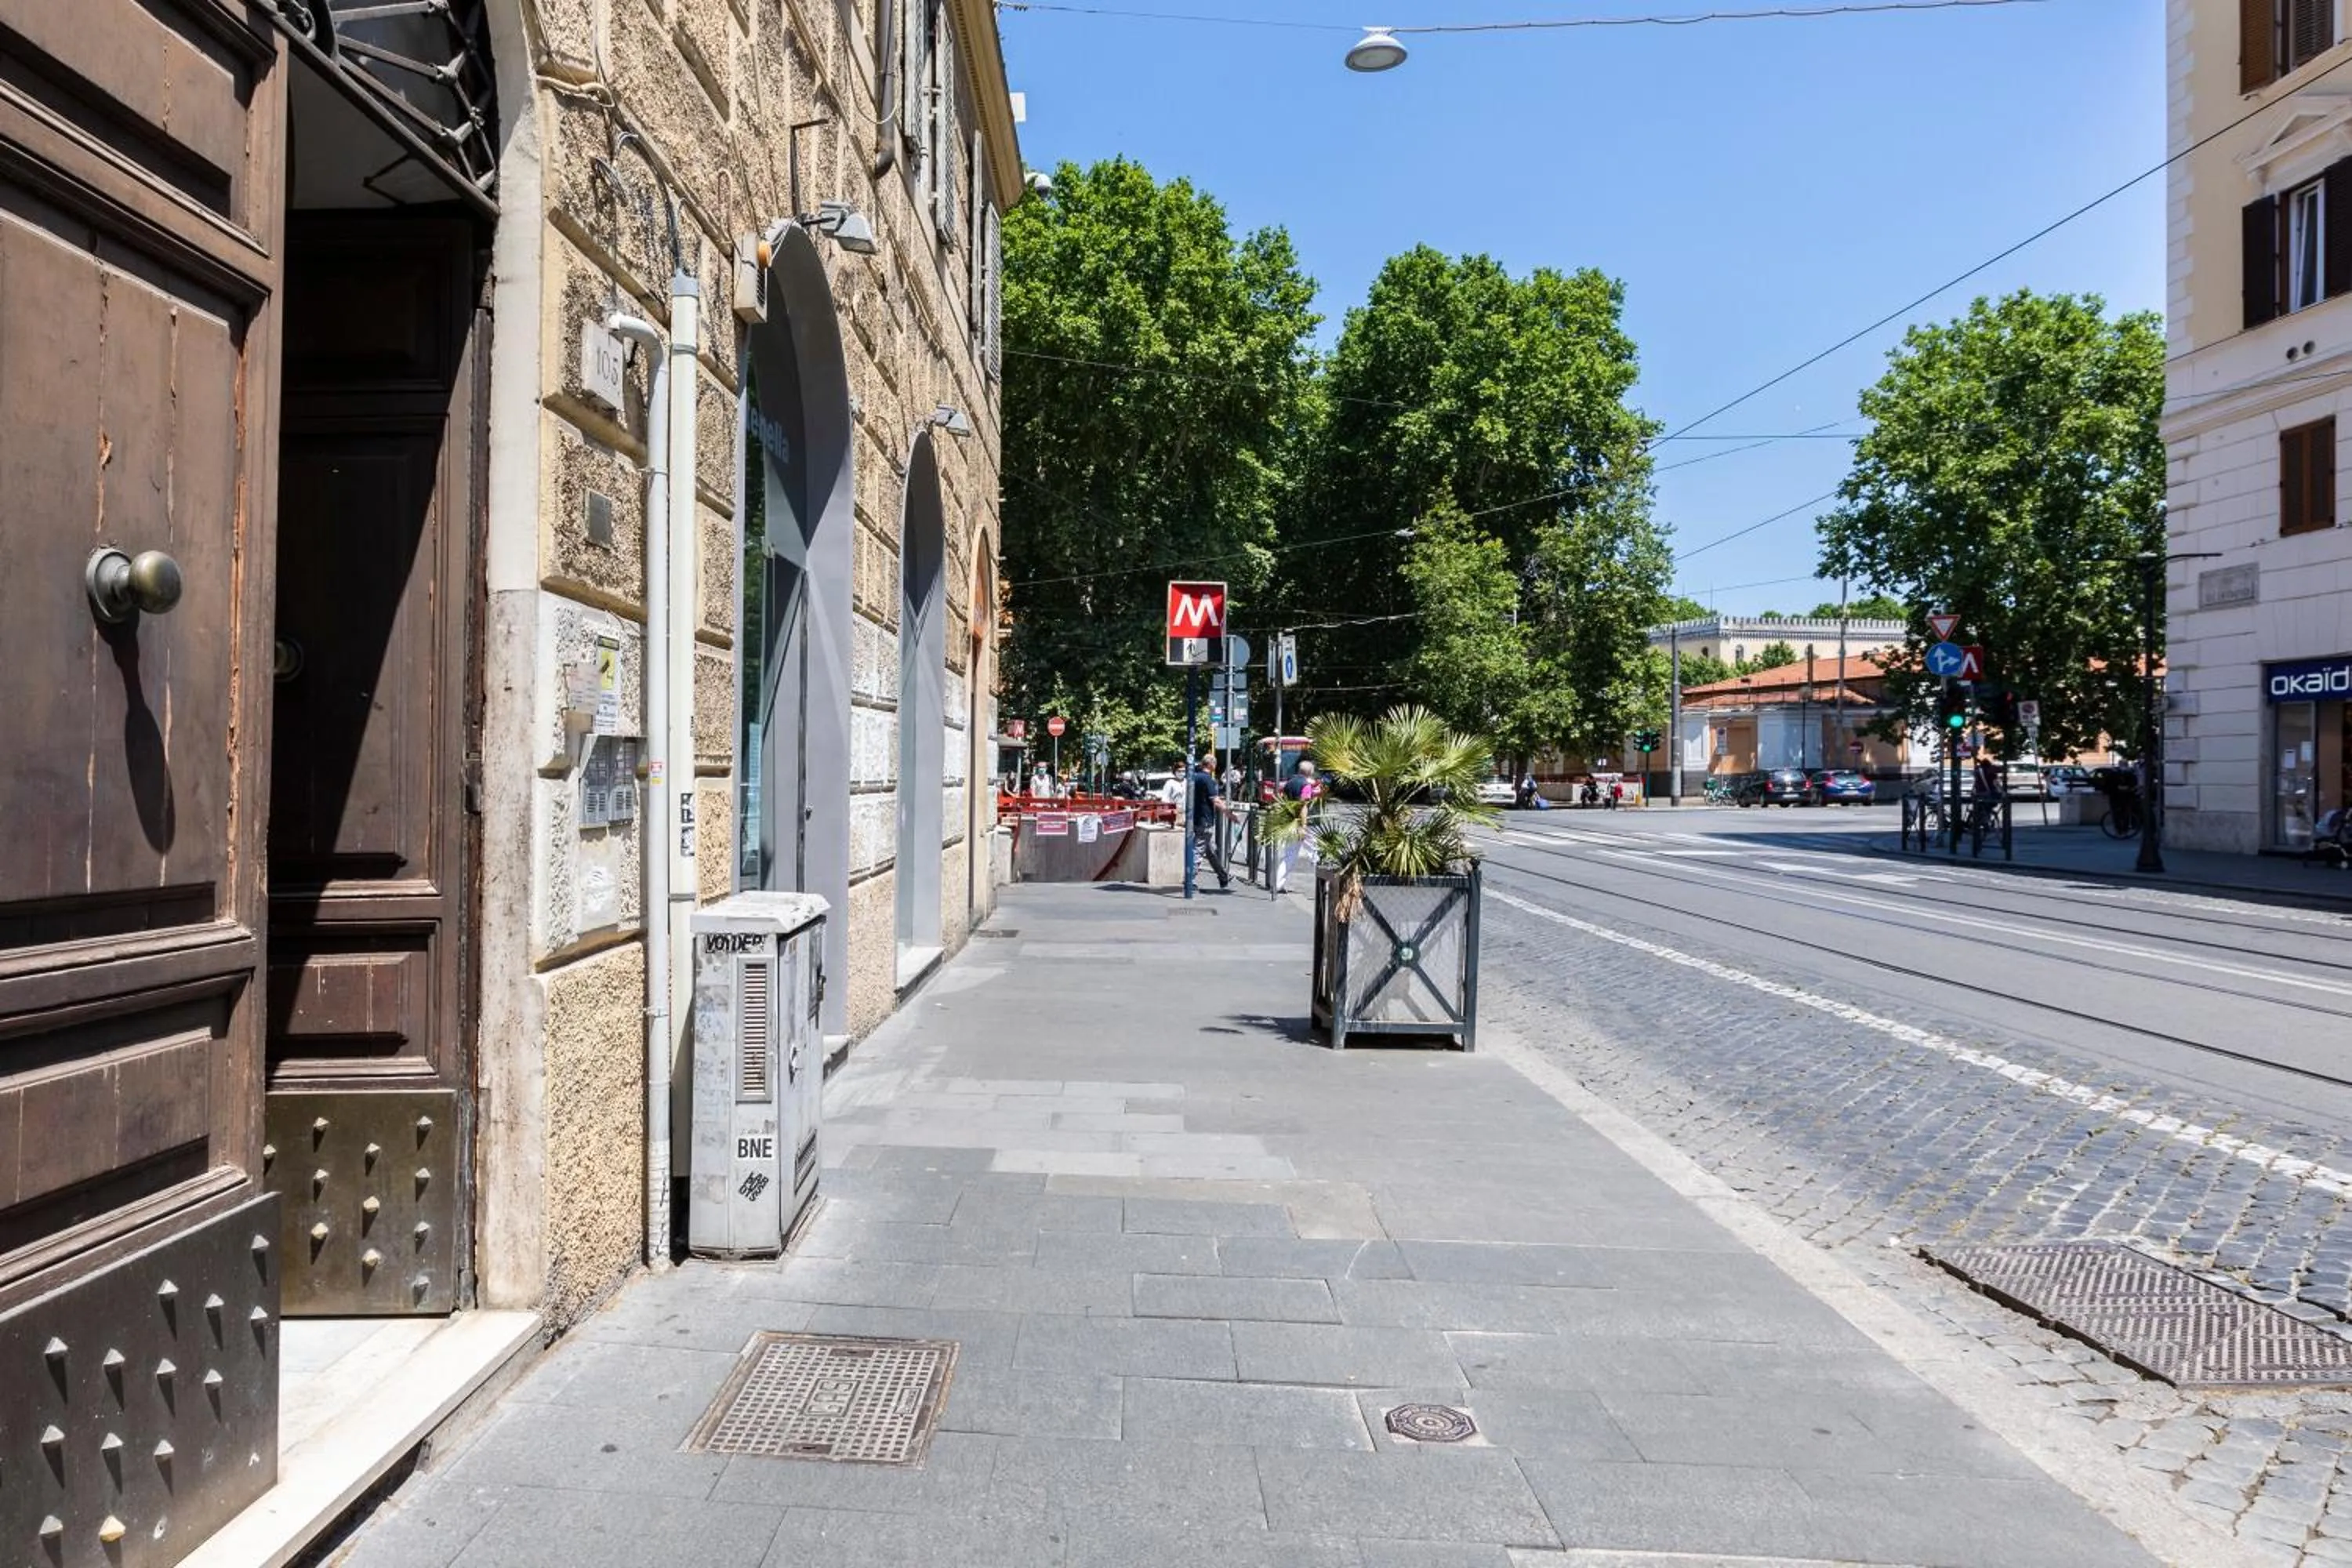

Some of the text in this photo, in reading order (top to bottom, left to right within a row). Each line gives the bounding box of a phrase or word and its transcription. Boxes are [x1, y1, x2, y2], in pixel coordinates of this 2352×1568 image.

[597, 347, 619, 386] 105
[1172, 593, 1220, 626] M
[2270, 665, 2352, 695] okaïd
[738, 1138, 772, 1158] BNE
